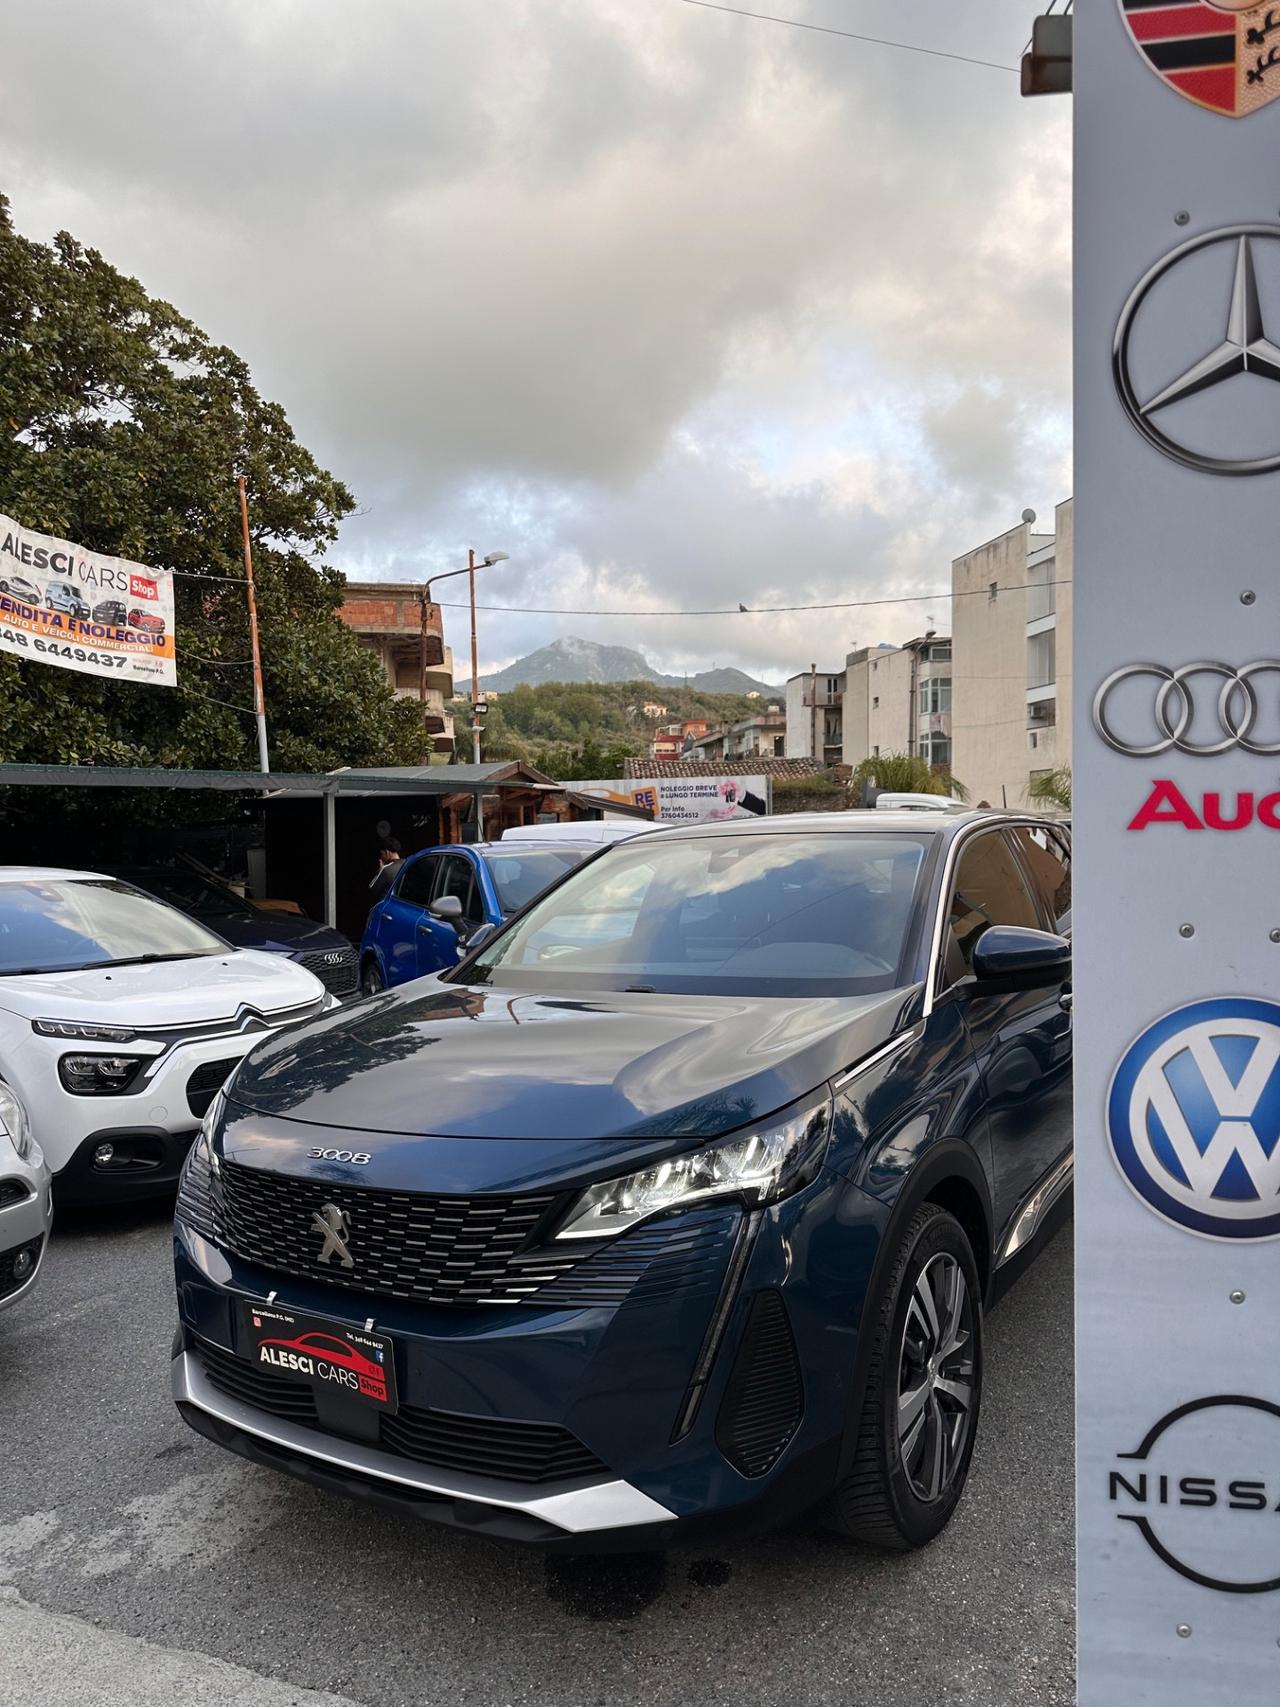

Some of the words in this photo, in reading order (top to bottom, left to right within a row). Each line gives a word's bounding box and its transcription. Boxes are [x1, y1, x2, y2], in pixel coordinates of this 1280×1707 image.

[2, 532, 74, 577] ALESCI
[78, 561, 128, 592] CARS
[132, 580, 155, 600] Shop
[0, 596, 63, 628] ENDITA
[68, 618, 76, 631] E
[79, 622, 166, 648] NOLEGGIO
[3, 613, 30, 629] AUTO
[31, 623, 39, 632] E
[81, 636, 155, 653] COMMERCIALI
[34, 639, 128, 669] 6449437
[660, 785, 694, 793] NOLEGGIO
[695, 784, 718, 792] BREVE
[306, 1146, 372, 1165] 3008
[260, 1346, 315, 1376] ALESCI
[317, 1362, 360, 1390] CARS
[361, 1379, 385, 1397] Shop
[1109, 1471, 1280, 1512] NISS
